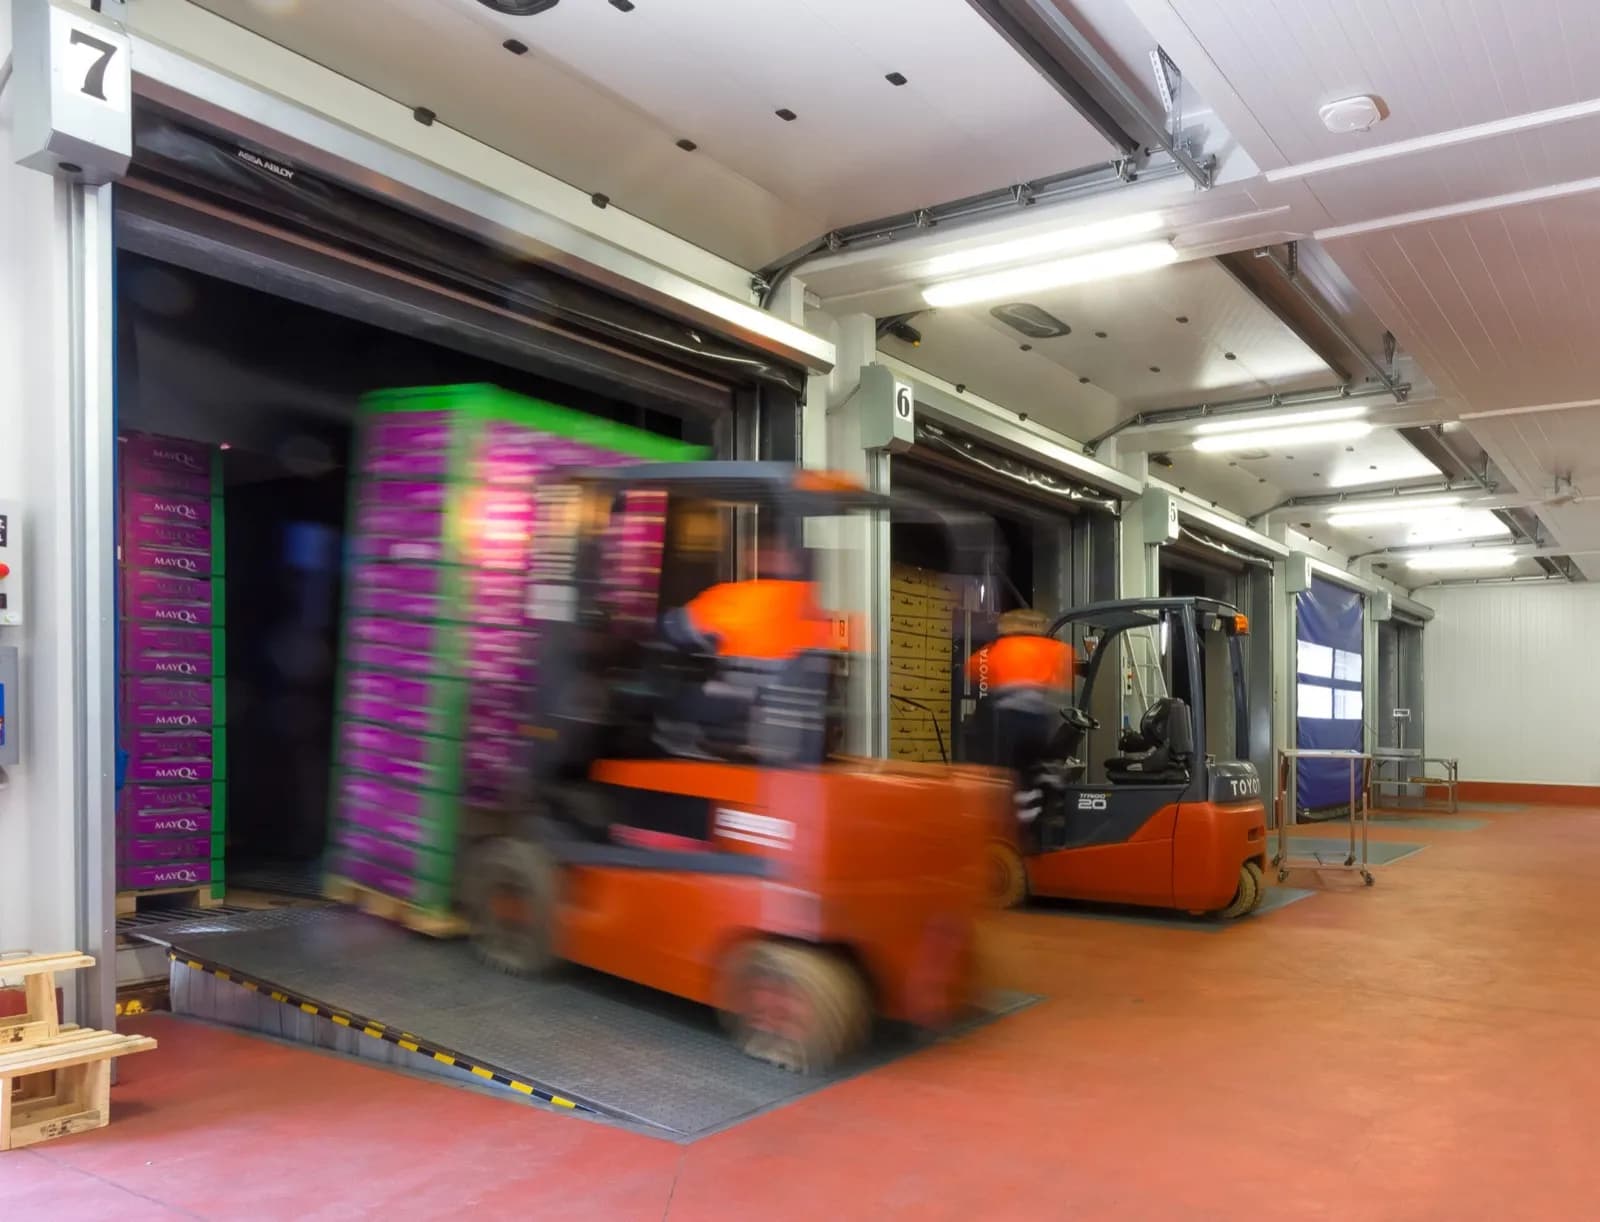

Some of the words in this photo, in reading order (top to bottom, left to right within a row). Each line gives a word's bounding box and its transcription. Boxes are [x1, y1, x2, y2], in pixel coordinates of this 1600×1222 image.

[69, 28, 118, 102] 7
[897, 387, 910, 418] 6
[154, 503, 199, 519] MAYQA
[1170, 502, 1177, 522] 5
[154, 557, 199, 572] MAYQA
[155, 610, 199, 624] MAYQA
[155, 661, 197, 675] MAYQA
[979, 648, 988, 700] TOYOTA
[156, 714, 198, 726] MAYQA
[155, 767, 199, 780] MAYQA
[1077, 798, 1107, 810] 20
[154, 818, 199, 832] MAYQA
[154, 869, 199, 882] MAYQA
